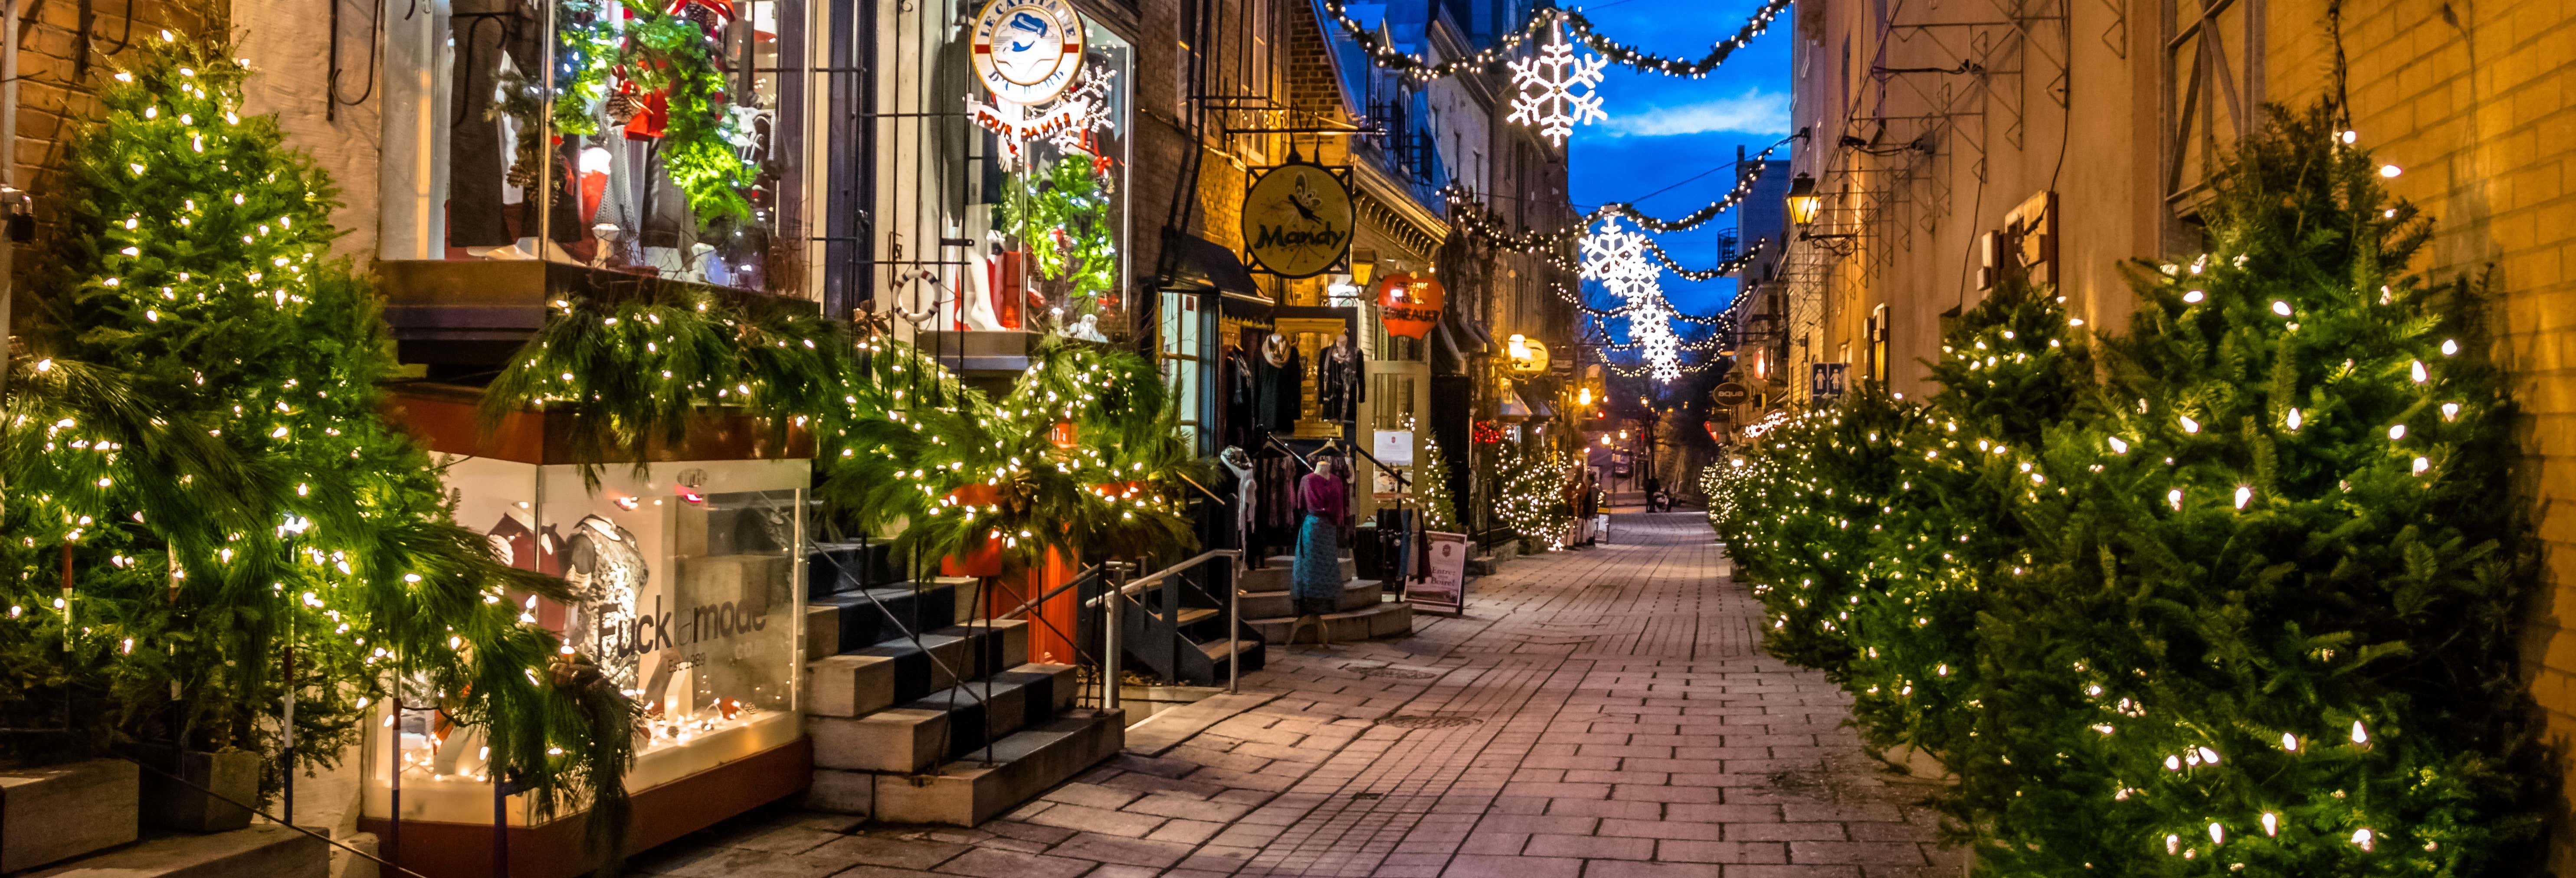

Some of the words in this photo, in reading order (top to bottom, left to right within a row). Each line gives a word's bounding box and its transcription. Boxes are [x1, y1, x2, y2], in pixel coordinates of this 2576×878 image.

[980, 16, 996, 38] LE
[977, 109, 1012, 140] POUR
[1254, 221, 1346, 250] Mandy
[597, 594, 673, 662] Fuck
